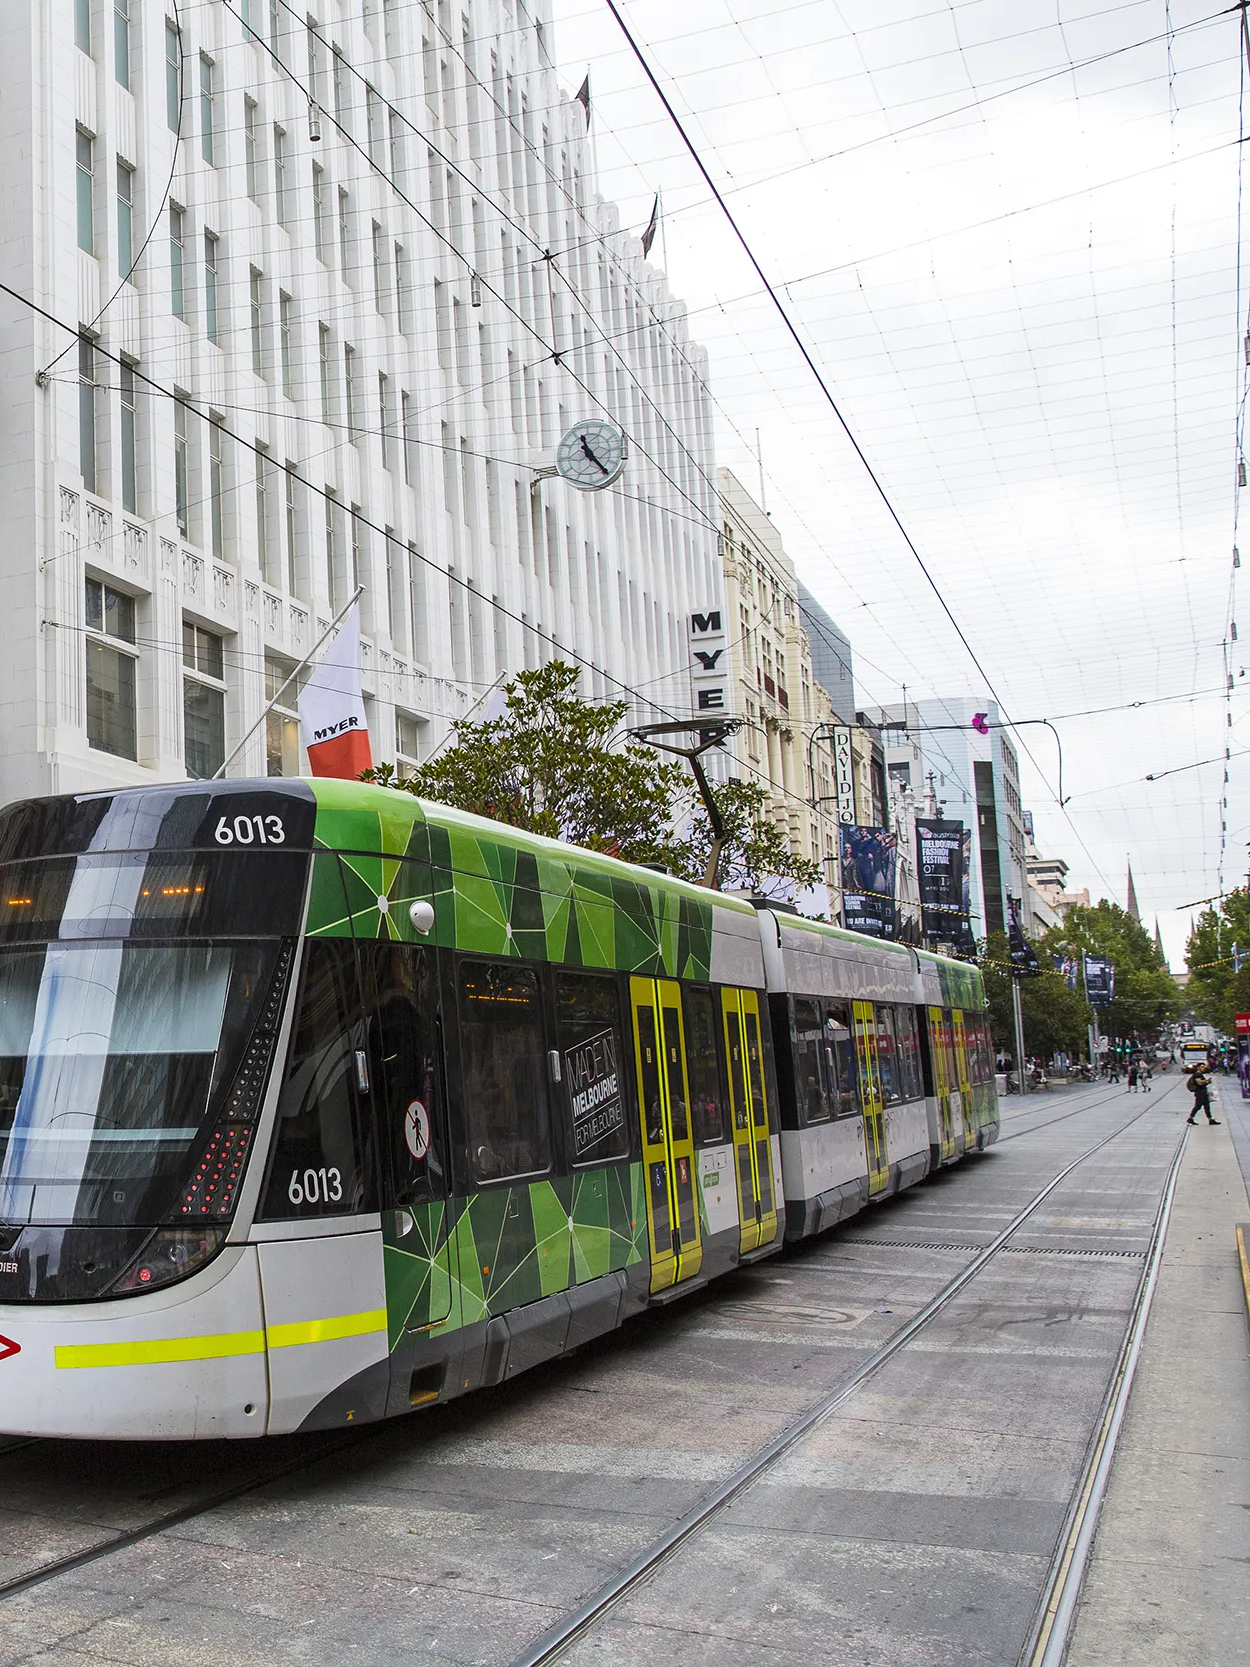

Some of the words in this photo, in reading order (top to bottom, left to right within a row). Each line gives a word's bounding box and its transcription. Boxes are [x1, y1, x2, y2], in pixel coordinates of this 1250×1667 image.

[691, 610, 727, 746] MYER
[314, 716, 359, 740] MYER
[837, 734, 851, 794] DAVID
[214, 815, 285, 845] 6013
[921, 840, 959, 850] MELBOURNE
[567, 1041, 604, 1093] MADE
[573, 1074, 618, 1118] MELBOURNE
[576, 1124, 589, 1148] FOR
[288, 1167, 342, 1204] 6013
